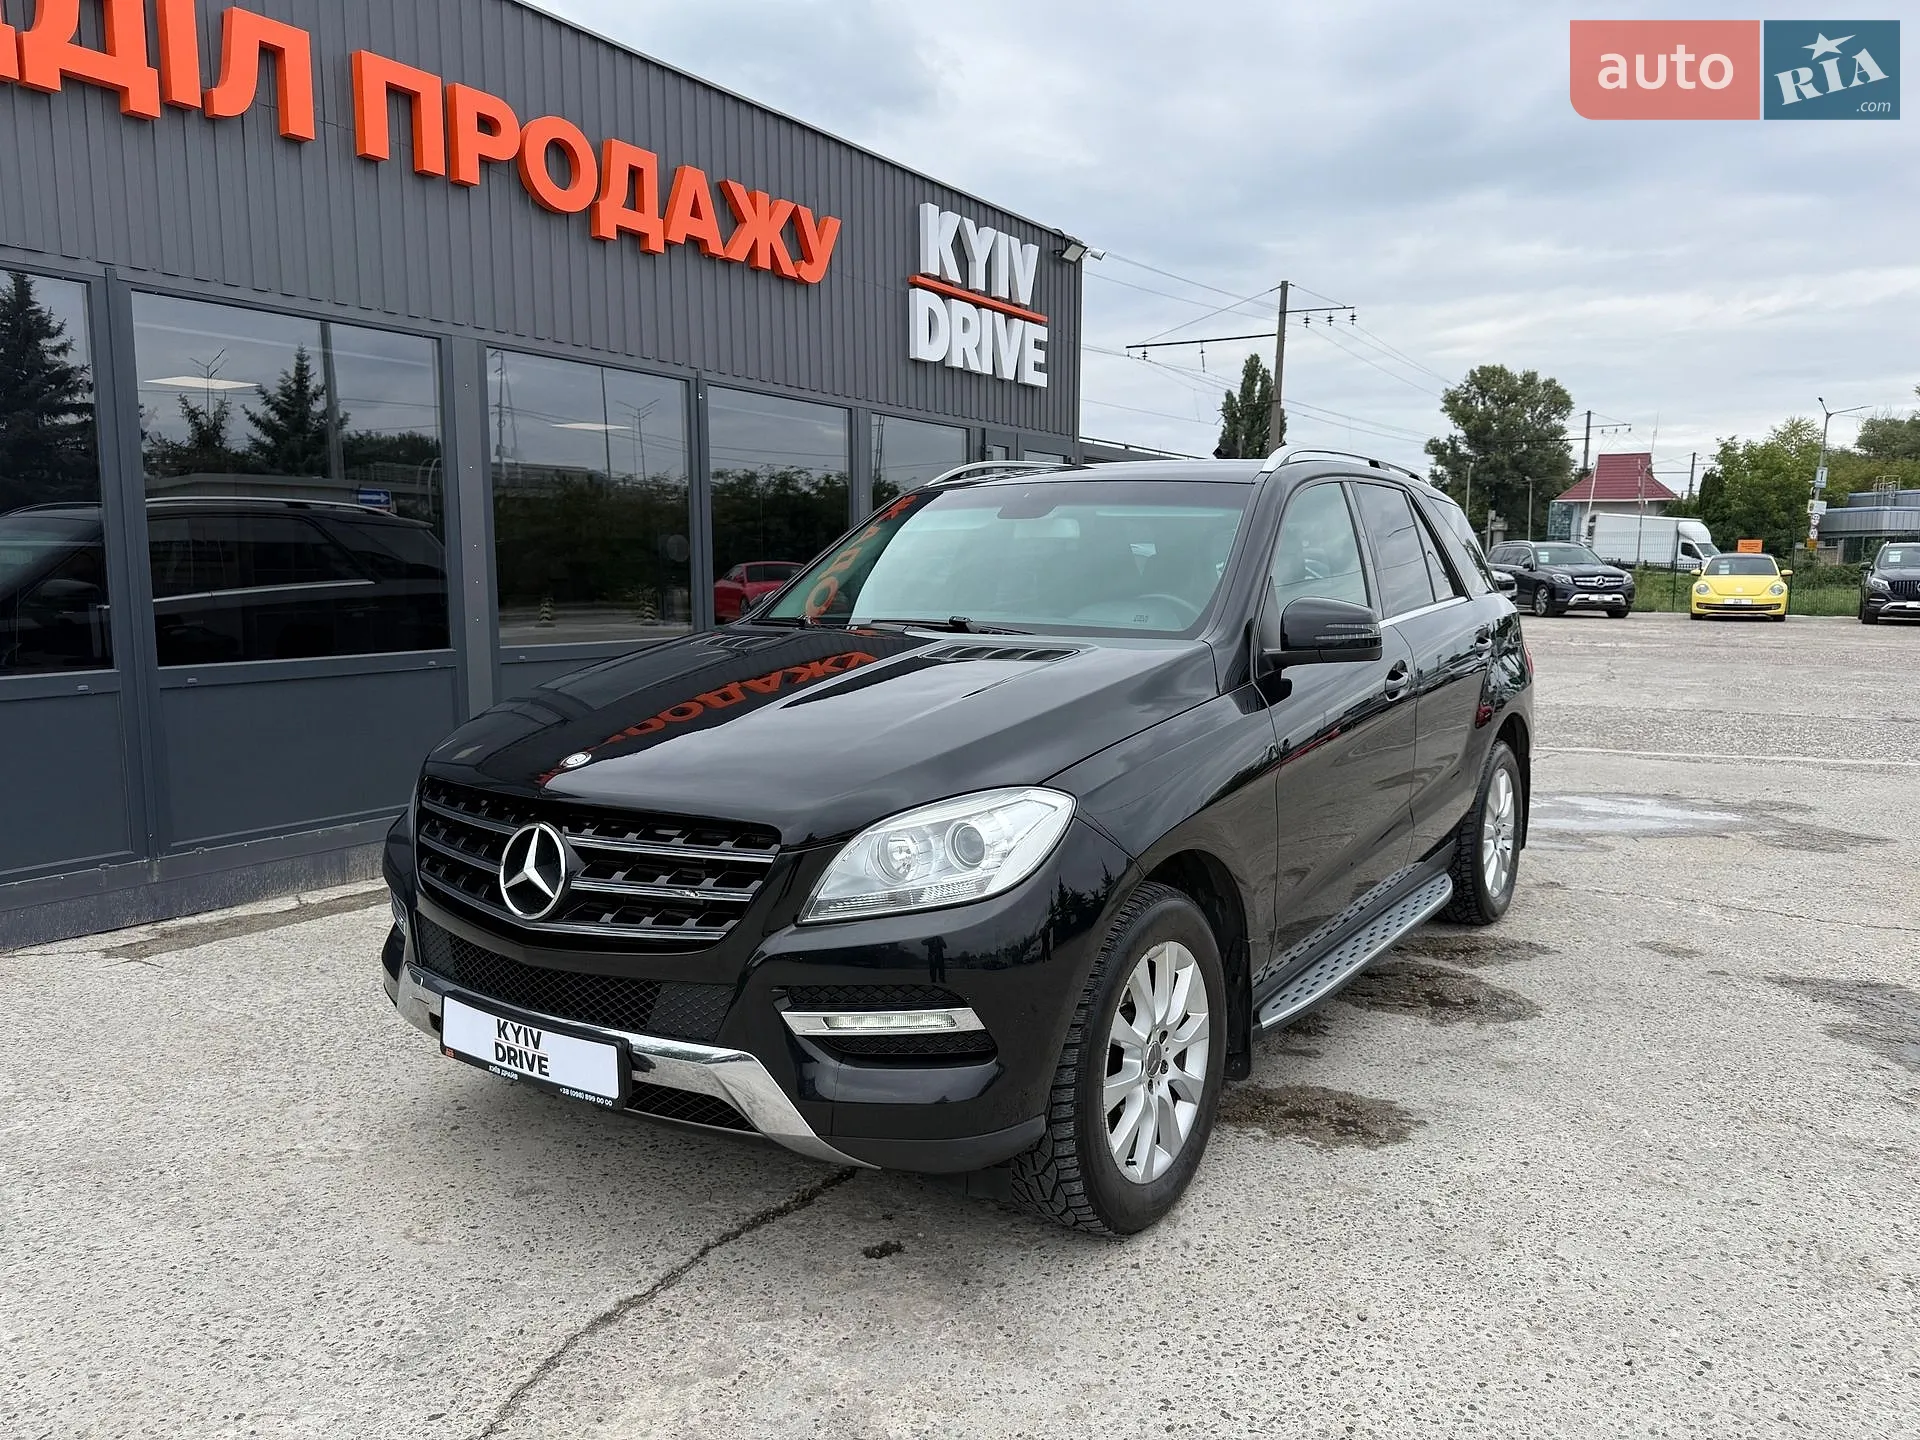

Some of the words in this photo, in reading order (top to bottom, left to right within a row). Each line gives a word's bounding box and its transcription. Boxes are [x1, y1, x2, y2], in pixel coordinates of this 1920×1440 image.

[0, 0, 315, 142] ДІЛ
[351, 49, 841, 284] ПРОДАЖУ
[919, 202, 1040, 307] KYIV
[908, 287, 1048, 388] DRIVE
[494, 1041, 550, 1077] DRIVE
[496, 1019, 542, 1050] KYIV
[597, 1096, 605, 1105] 00
[605, 1098, 613, 1107] 00
